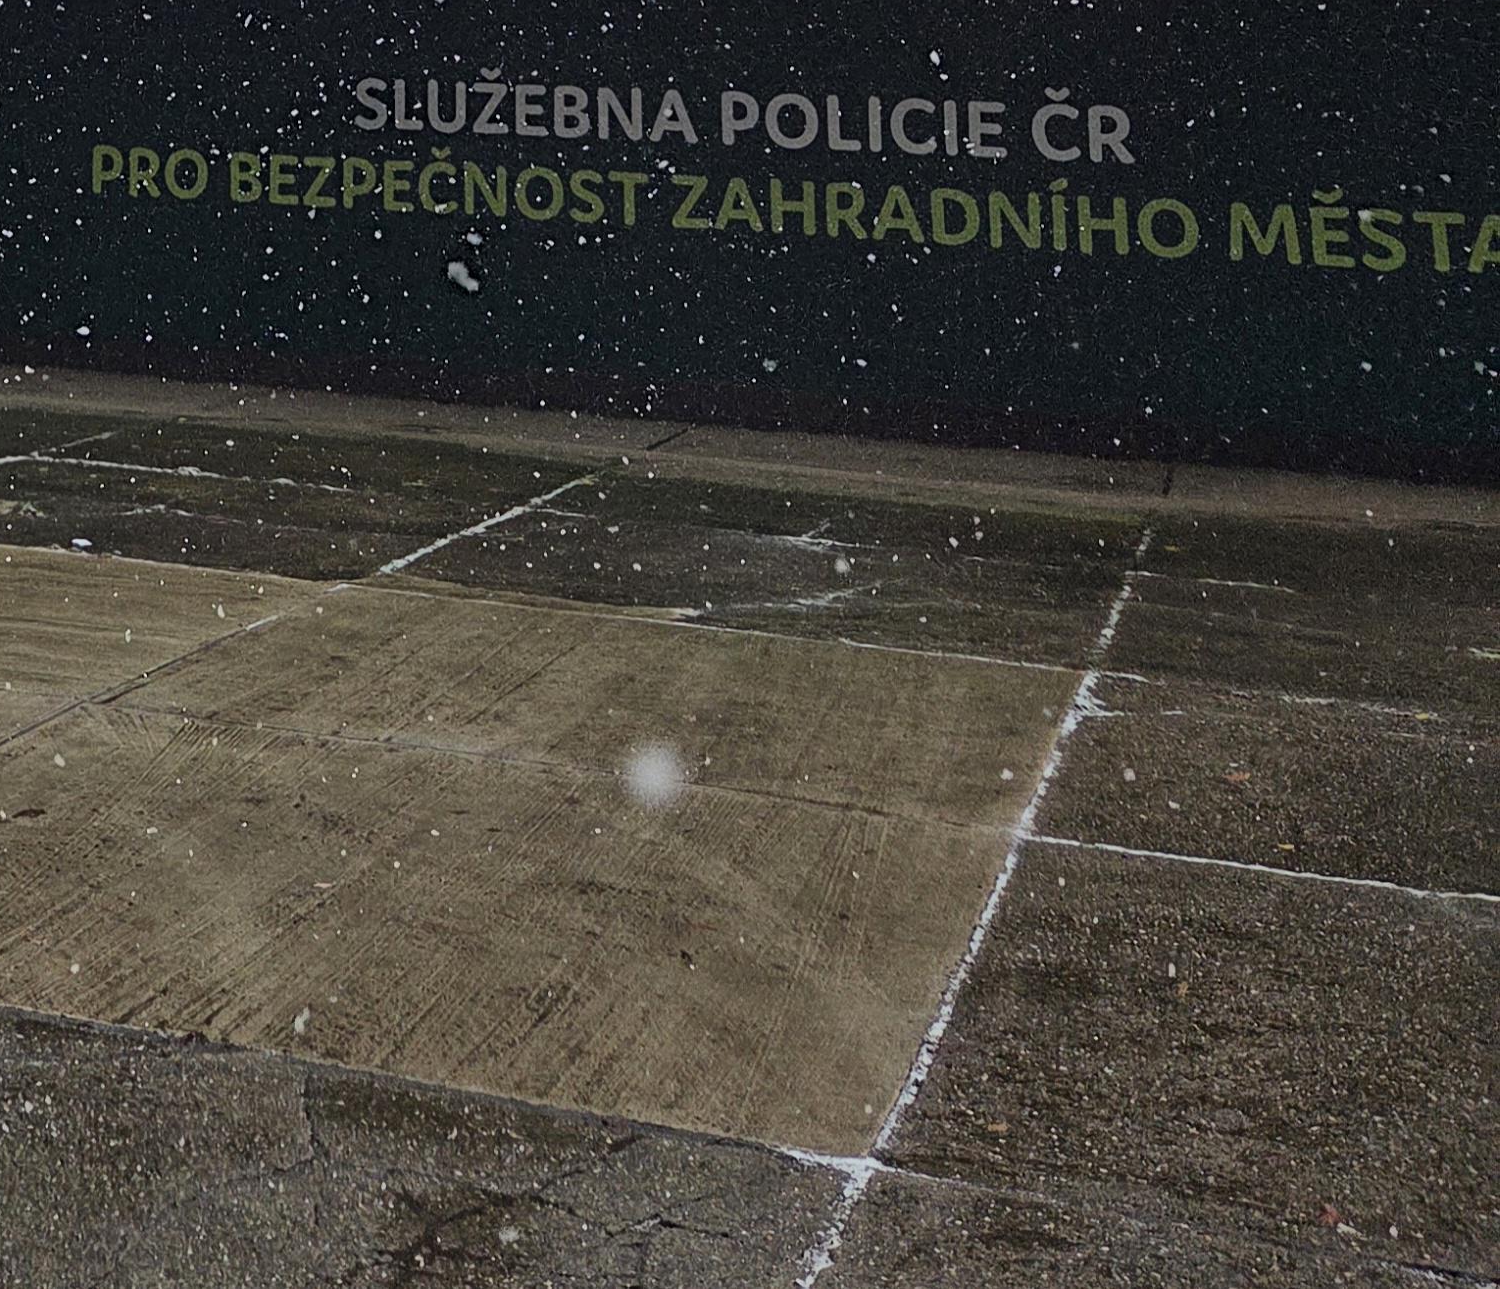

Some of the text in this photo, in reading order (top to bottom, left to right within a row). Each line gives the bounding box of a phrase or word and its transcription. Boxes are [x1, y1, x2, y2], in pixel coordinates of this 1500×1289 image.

[353, 67, 1136, 164] SLUŽEBNA POLICIE ČR
[91, 145, 1500, 273] PRO BEZPEČNOST ZAHRADNÍHO MĚSTA
